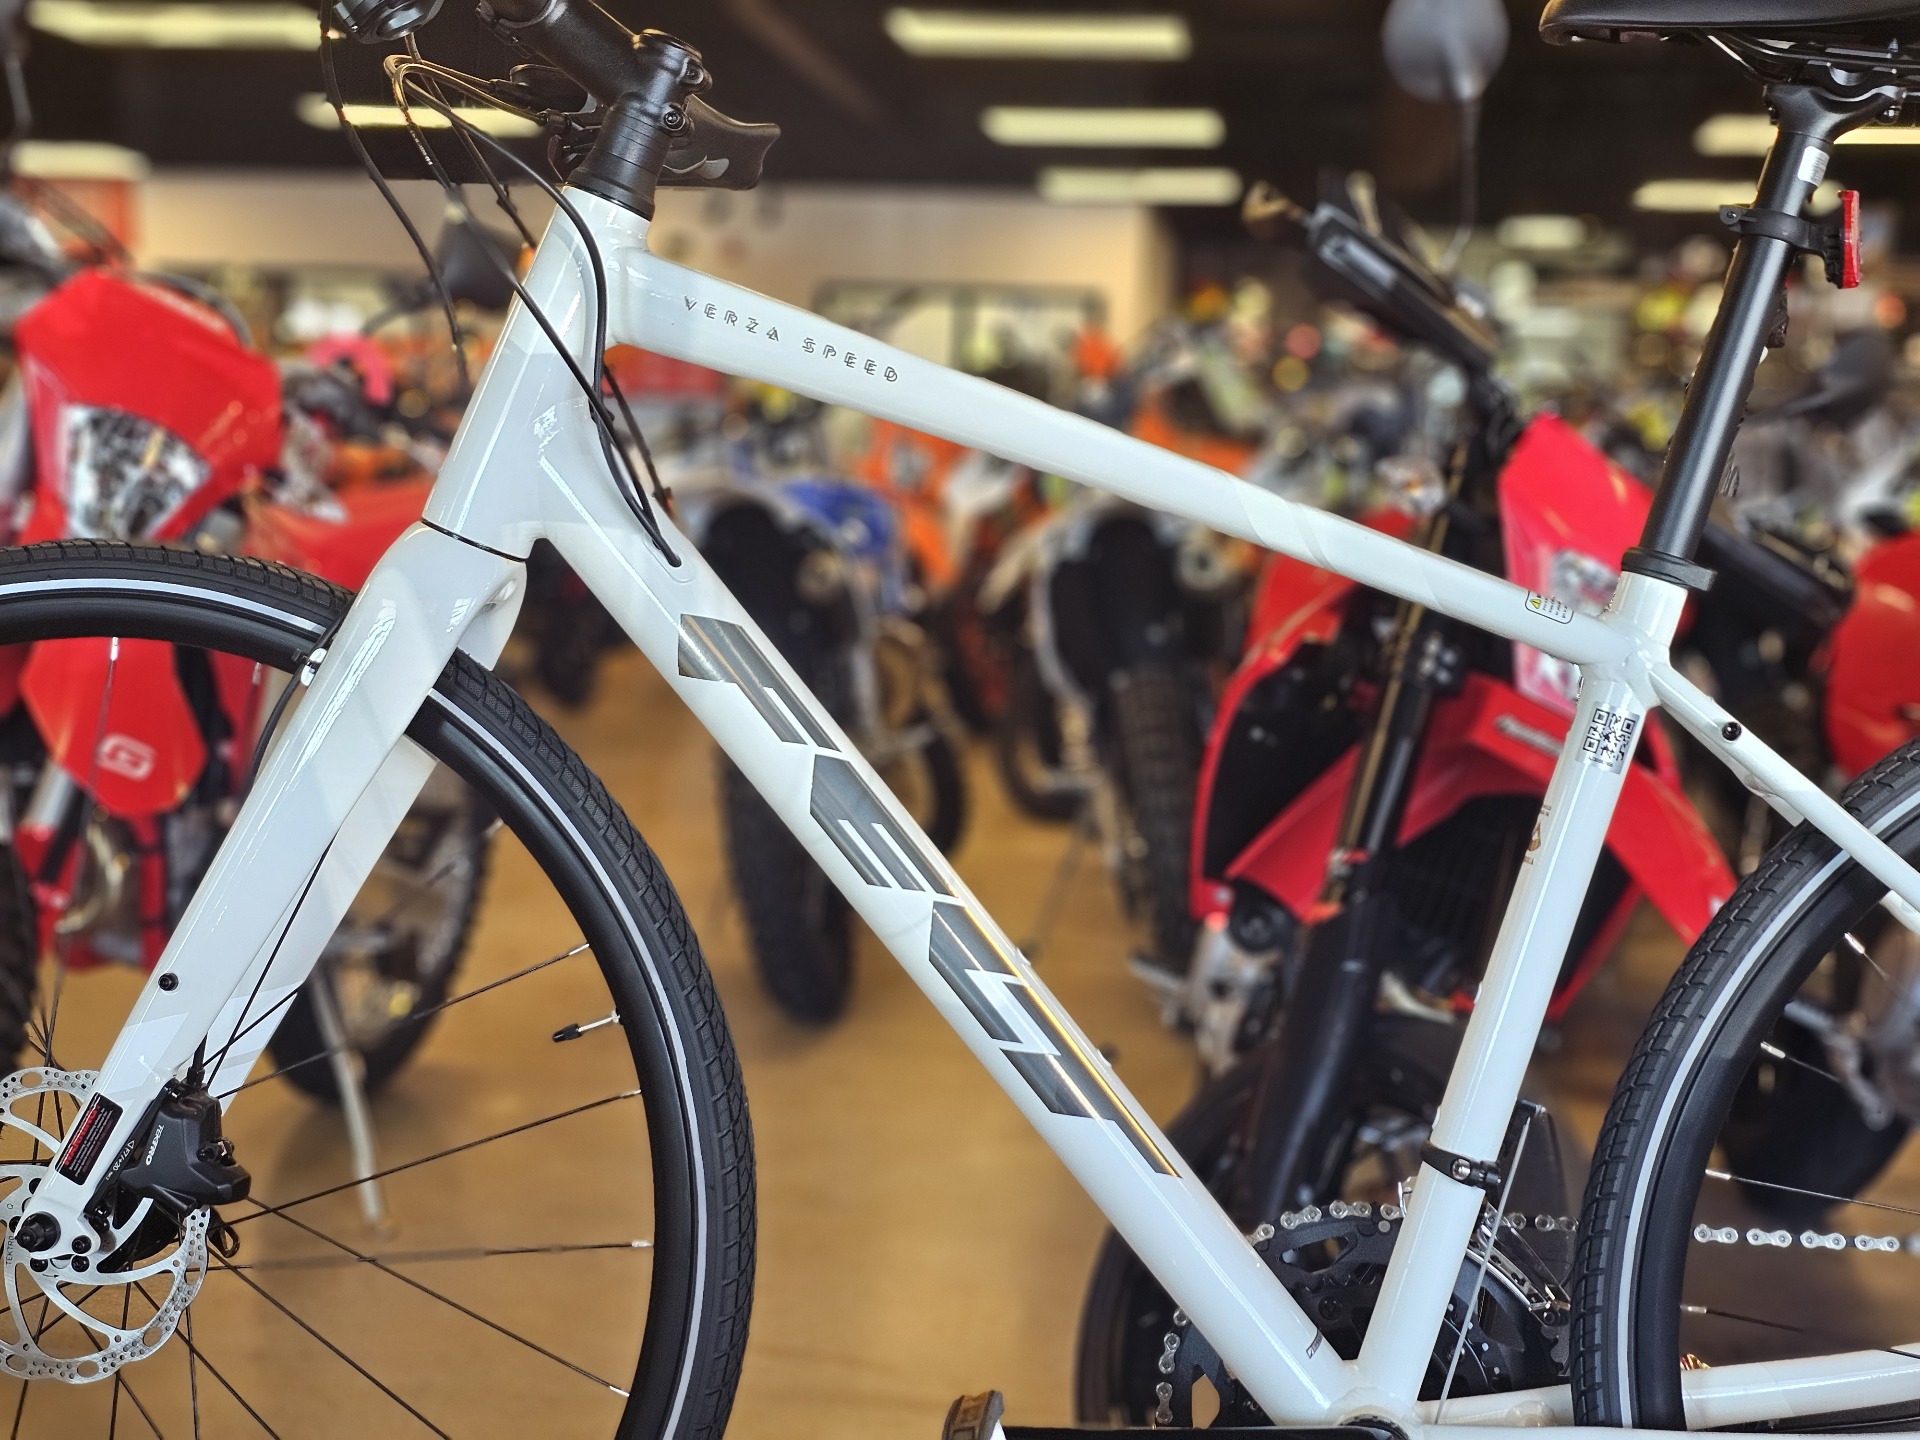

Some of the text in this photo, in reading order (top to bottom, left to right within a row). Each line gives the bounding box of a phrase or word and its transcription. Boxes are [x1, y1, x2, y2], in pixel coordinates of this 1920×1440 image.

[684, 296, 898, 382] VERZA SPEED
[678, 614, 1182, 1178] FELT
[145, 1124, 165, 1166] TEKTRO
[6, 1235, 15, 1266] TEKTRO
